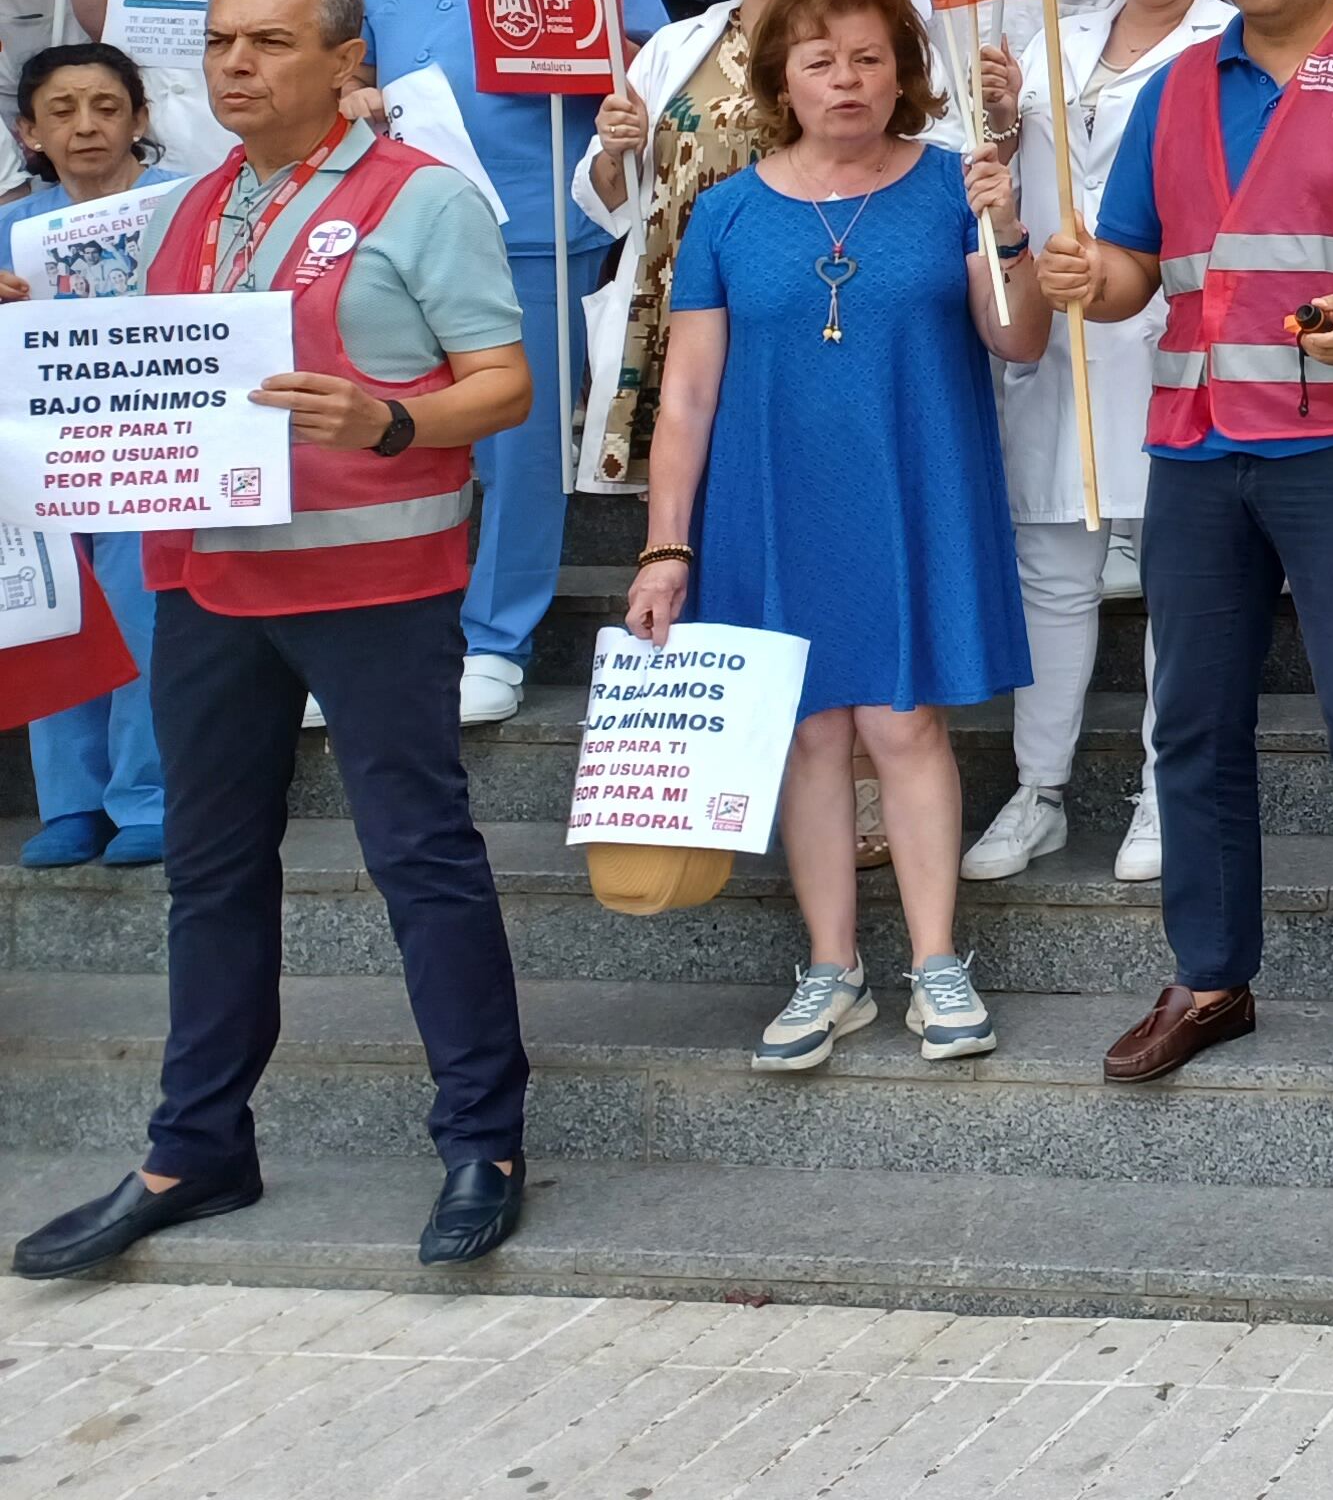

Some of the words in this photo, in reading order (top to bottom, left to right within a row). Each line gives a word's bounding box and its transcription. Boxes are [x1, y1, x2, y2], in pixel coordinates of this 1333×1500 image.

[111, 218, 132, 231] EN
[24, 331, 59, 348] EN
[69, 329, 98, 346] MI
[108, 323, 230, 345] SERVICIO
[38, 357, 220, 381] TRABAJAMOS
[30, 396, 101, 416] BAJO
[110, 389, 227, 412] MÍNIMOS
[59, 425, 113, 440] PEOR
[119, 423, 168, 437] PARA
[173, 421, 192, 434] TI
[45, 450, 105, 464] COMO
[112, 445, 199, 462] USUARIO
[44, 473, 103, 489] PEOR
[110, 470, 168, 486] PARA
[175, 468, 200, 483] MI
[35, 501, 100, 517] SALUD
[108, 497, 211, 515] LABORAL
[612, 653, 641, 671] MI
[618, 708, 725, 733] MÍNIMOS
[618, 740, 662, 753] PARA
[669, 741, 687, 754] TI
[609, 764, 690, 778] USUARIO
[602, 785, 654, 800] PARA
[662, 787, 688, 802] MI
[595, 812, 694, 830] LABORAL
